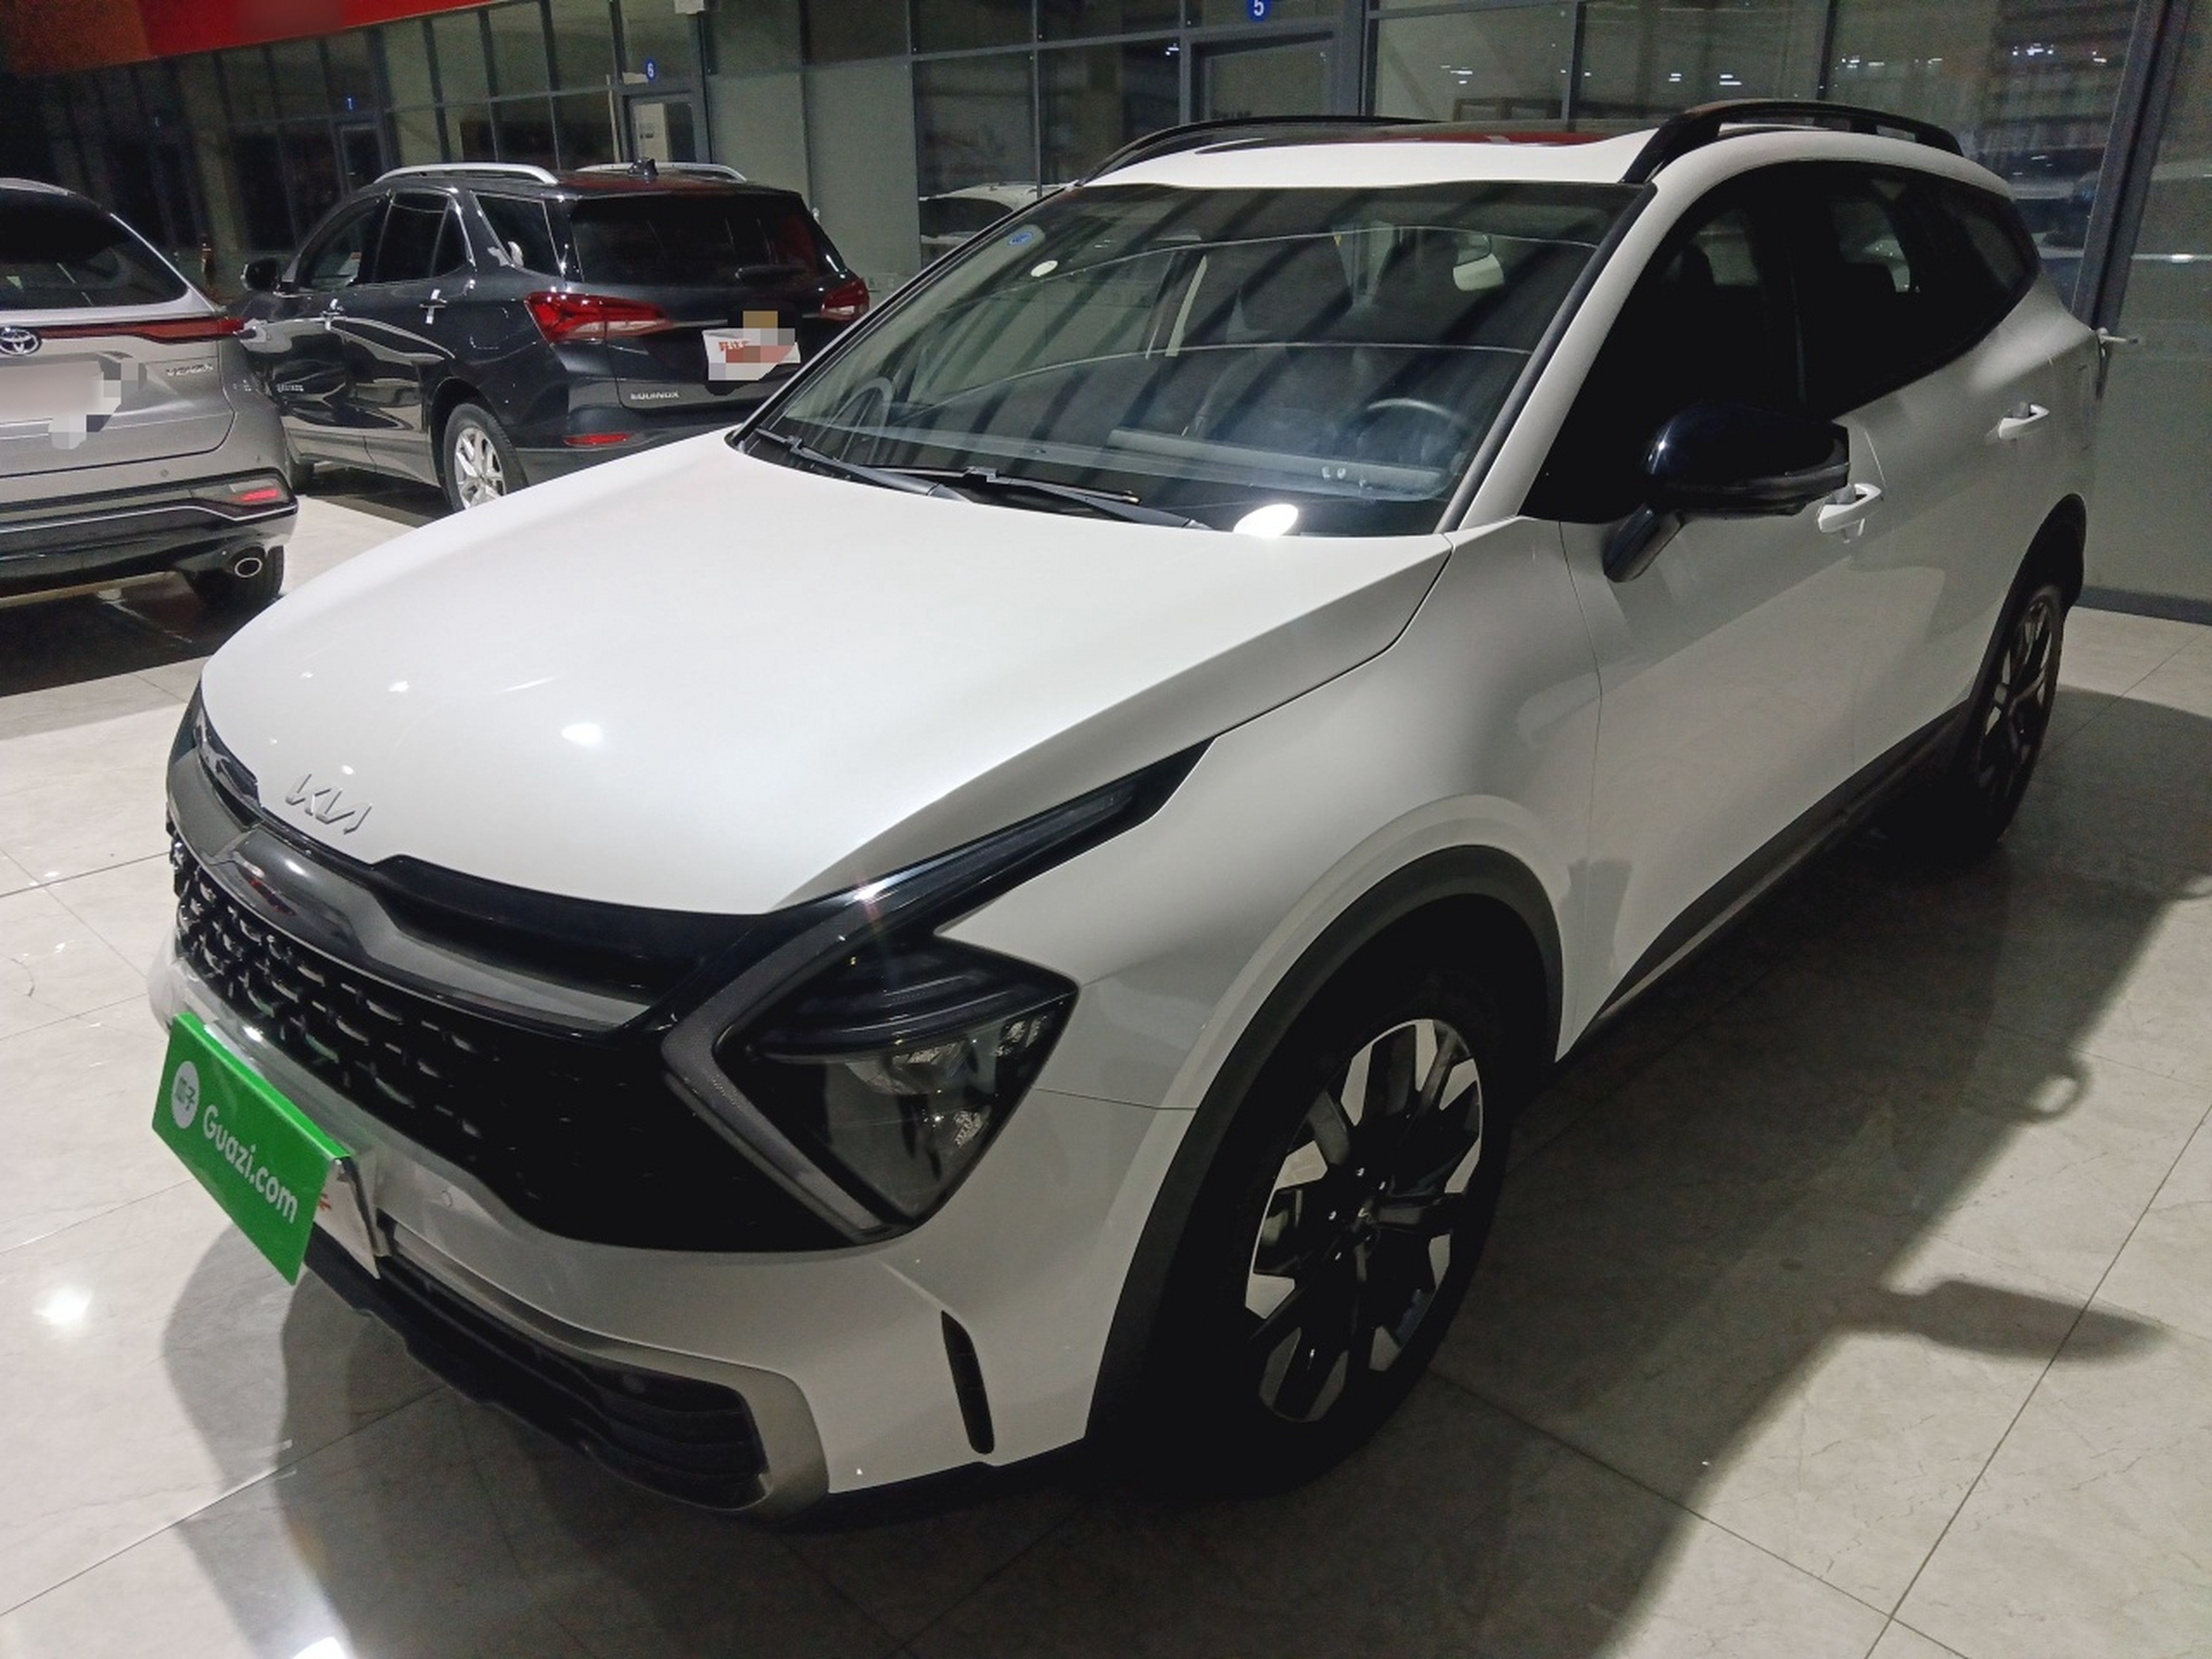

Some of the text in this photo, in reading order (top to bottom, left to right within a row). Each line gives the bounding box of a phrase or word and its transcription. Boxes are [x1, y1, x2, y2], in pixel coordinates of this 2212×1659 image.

[1254, 0, 1264, 16] 5
[647, 63, 654, 78] 6
[286, 773, 373, 835] KIA
[203, 1104, 298, 1224] Guazi.com
